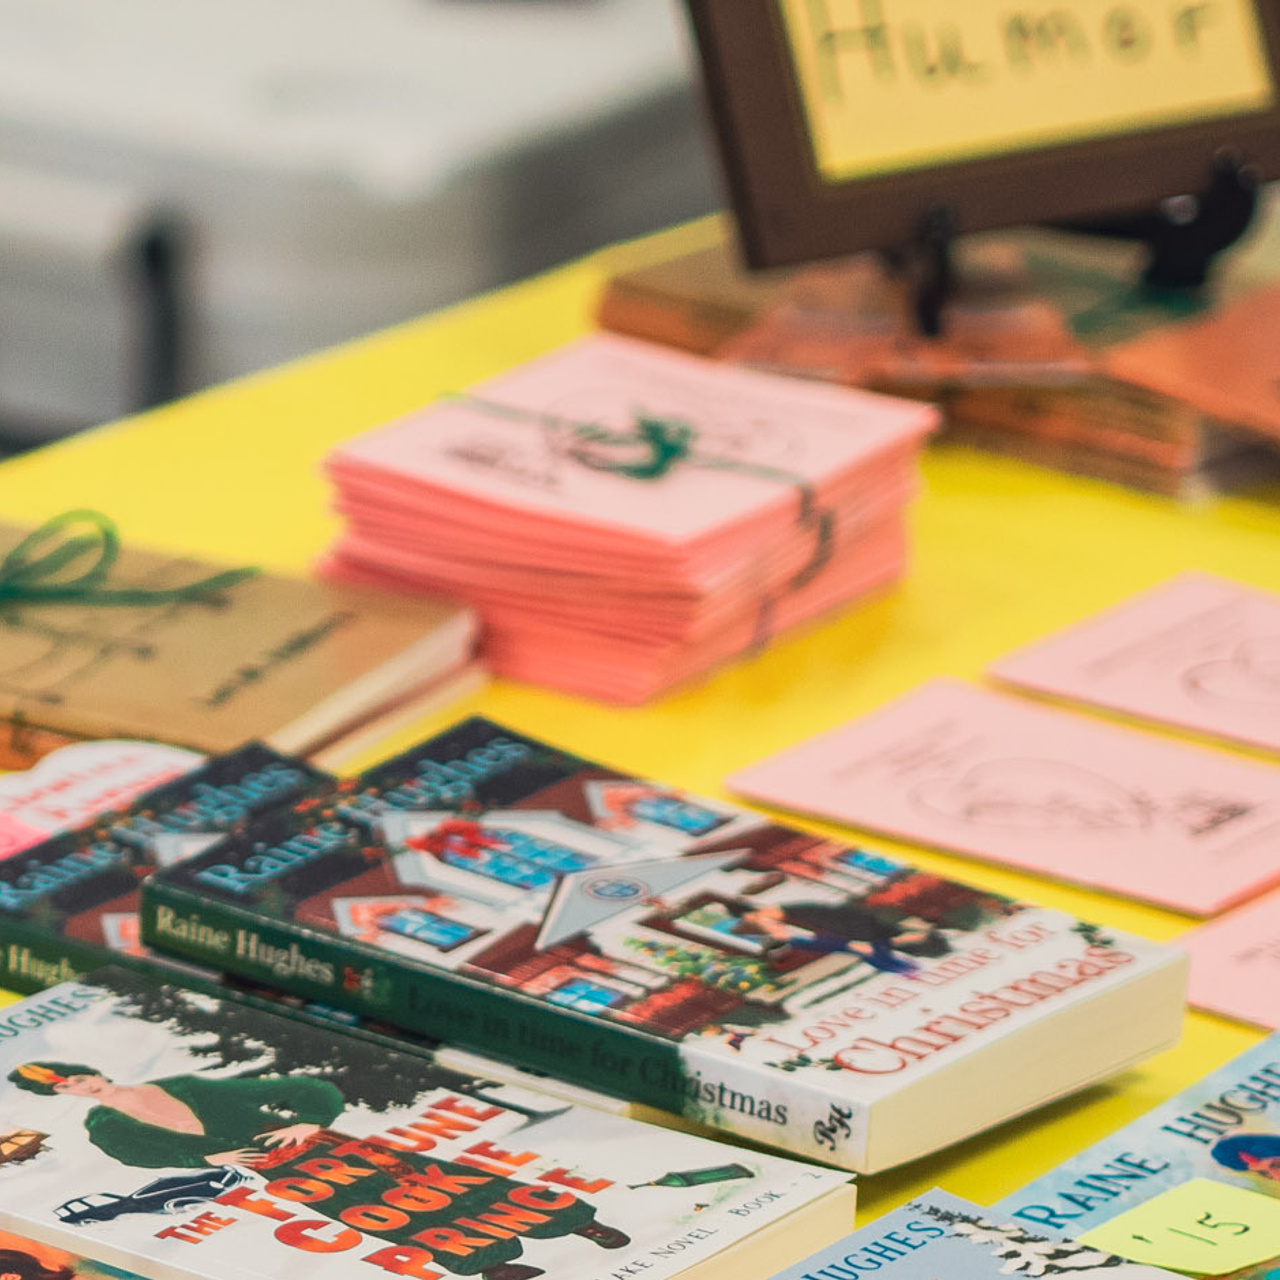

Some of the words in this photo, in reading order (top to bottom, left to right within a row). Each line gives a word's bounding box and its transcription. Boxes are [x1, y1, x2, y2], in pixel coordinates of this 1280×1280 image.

[808, 0, 1224, 103] Humor
[197, 821, 350, 893] Raine
[335, 736, 530, 828] Hughes
[157, 904, 231, 951] Raine
[236, 929, 336, 985] Hughes
[833, 946, 1137, 1076] Christmas
[640, 1055, 790, 1128] Christmas
[153, 1209, 238, 1245] THE
[215, 1096, 507, 1223] FORTUNE
[274, 1140, 543, 1254] COOKIE
[1013, 1151, 1171, 1231] RAINE
[651, 1225, 720, 1261] NOVEL
[727, 1188, 786, 1218] BOOK
